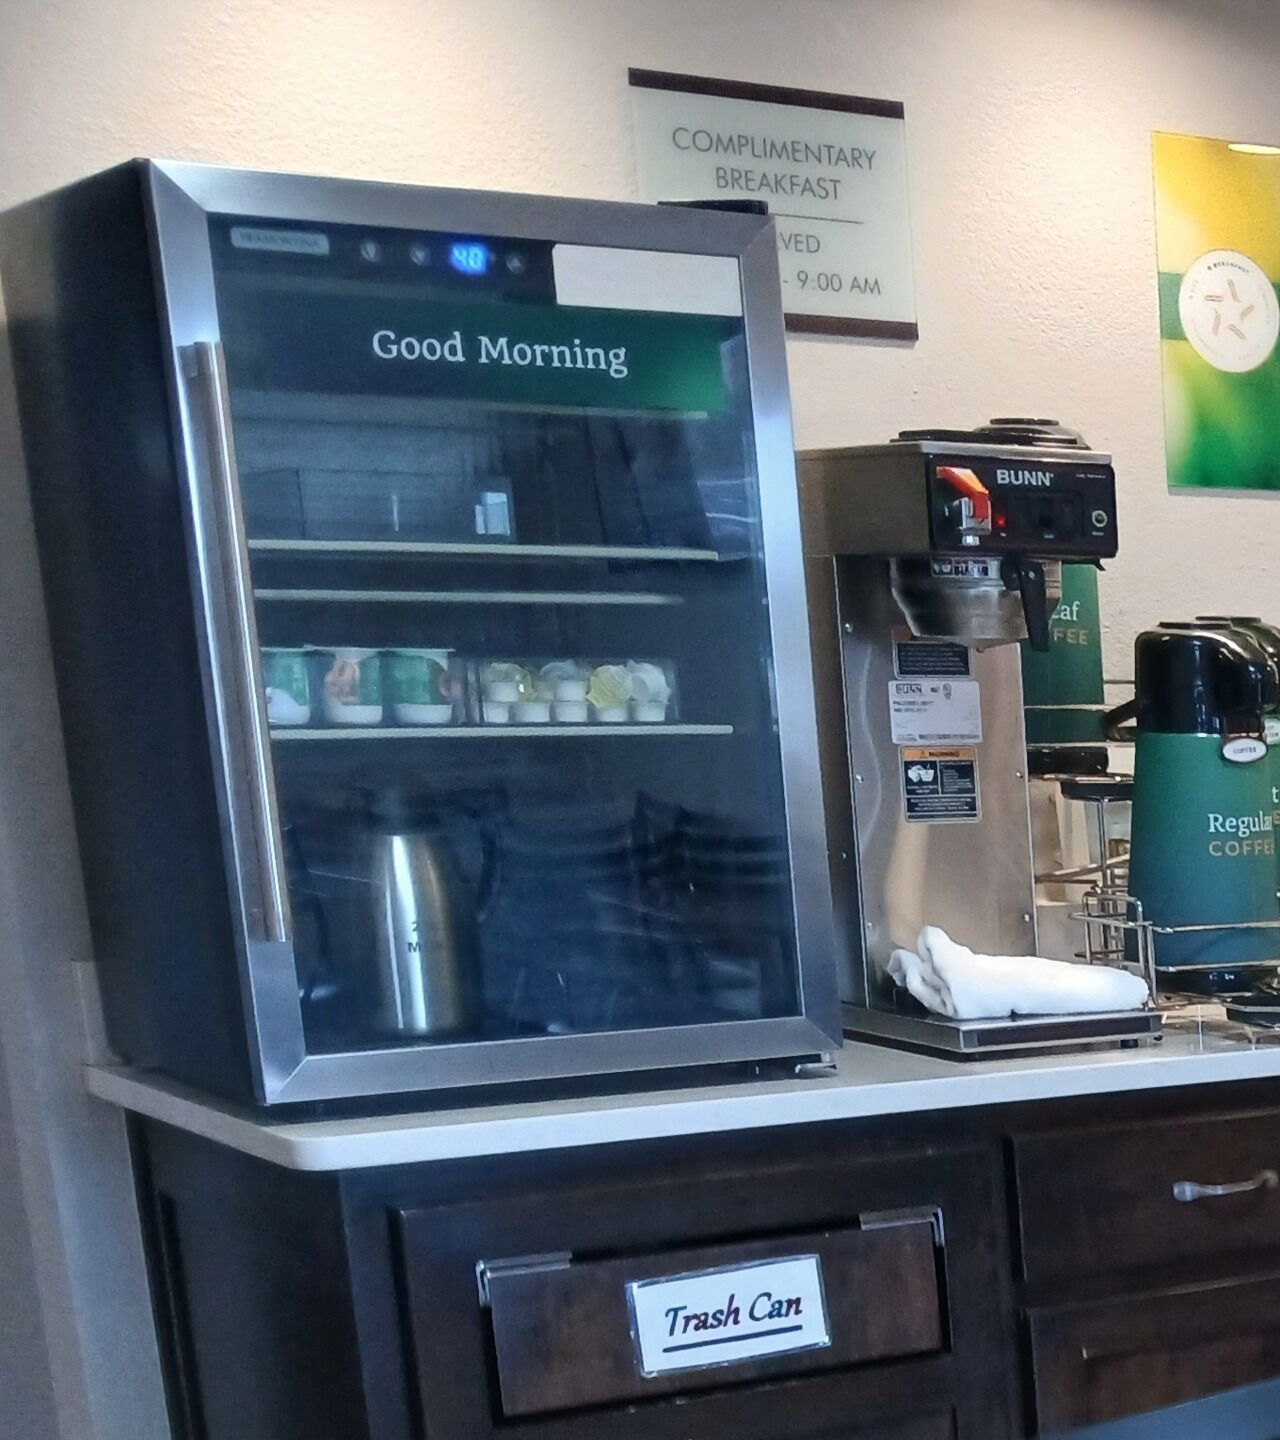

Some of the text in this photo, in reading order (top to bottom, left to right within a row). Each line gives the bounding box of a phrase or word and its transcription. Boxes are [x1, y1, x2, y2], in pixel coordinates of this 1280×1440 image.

[671, 126, 877, 171] COMPLIMENTARY
[715, 166, 841, 201] BREAKFAST
[777, 231, 821, 254] VED
[796, 269, 843, 293] 9:00
[849, 275, 882, 296] AM
[372, 329, 629, 379] Good Morning
[996, 469, 1051, 487] BUNN
[1053, 627, 1089, 646] FEE
[664, 1291, 803, 1337] Trash Can
